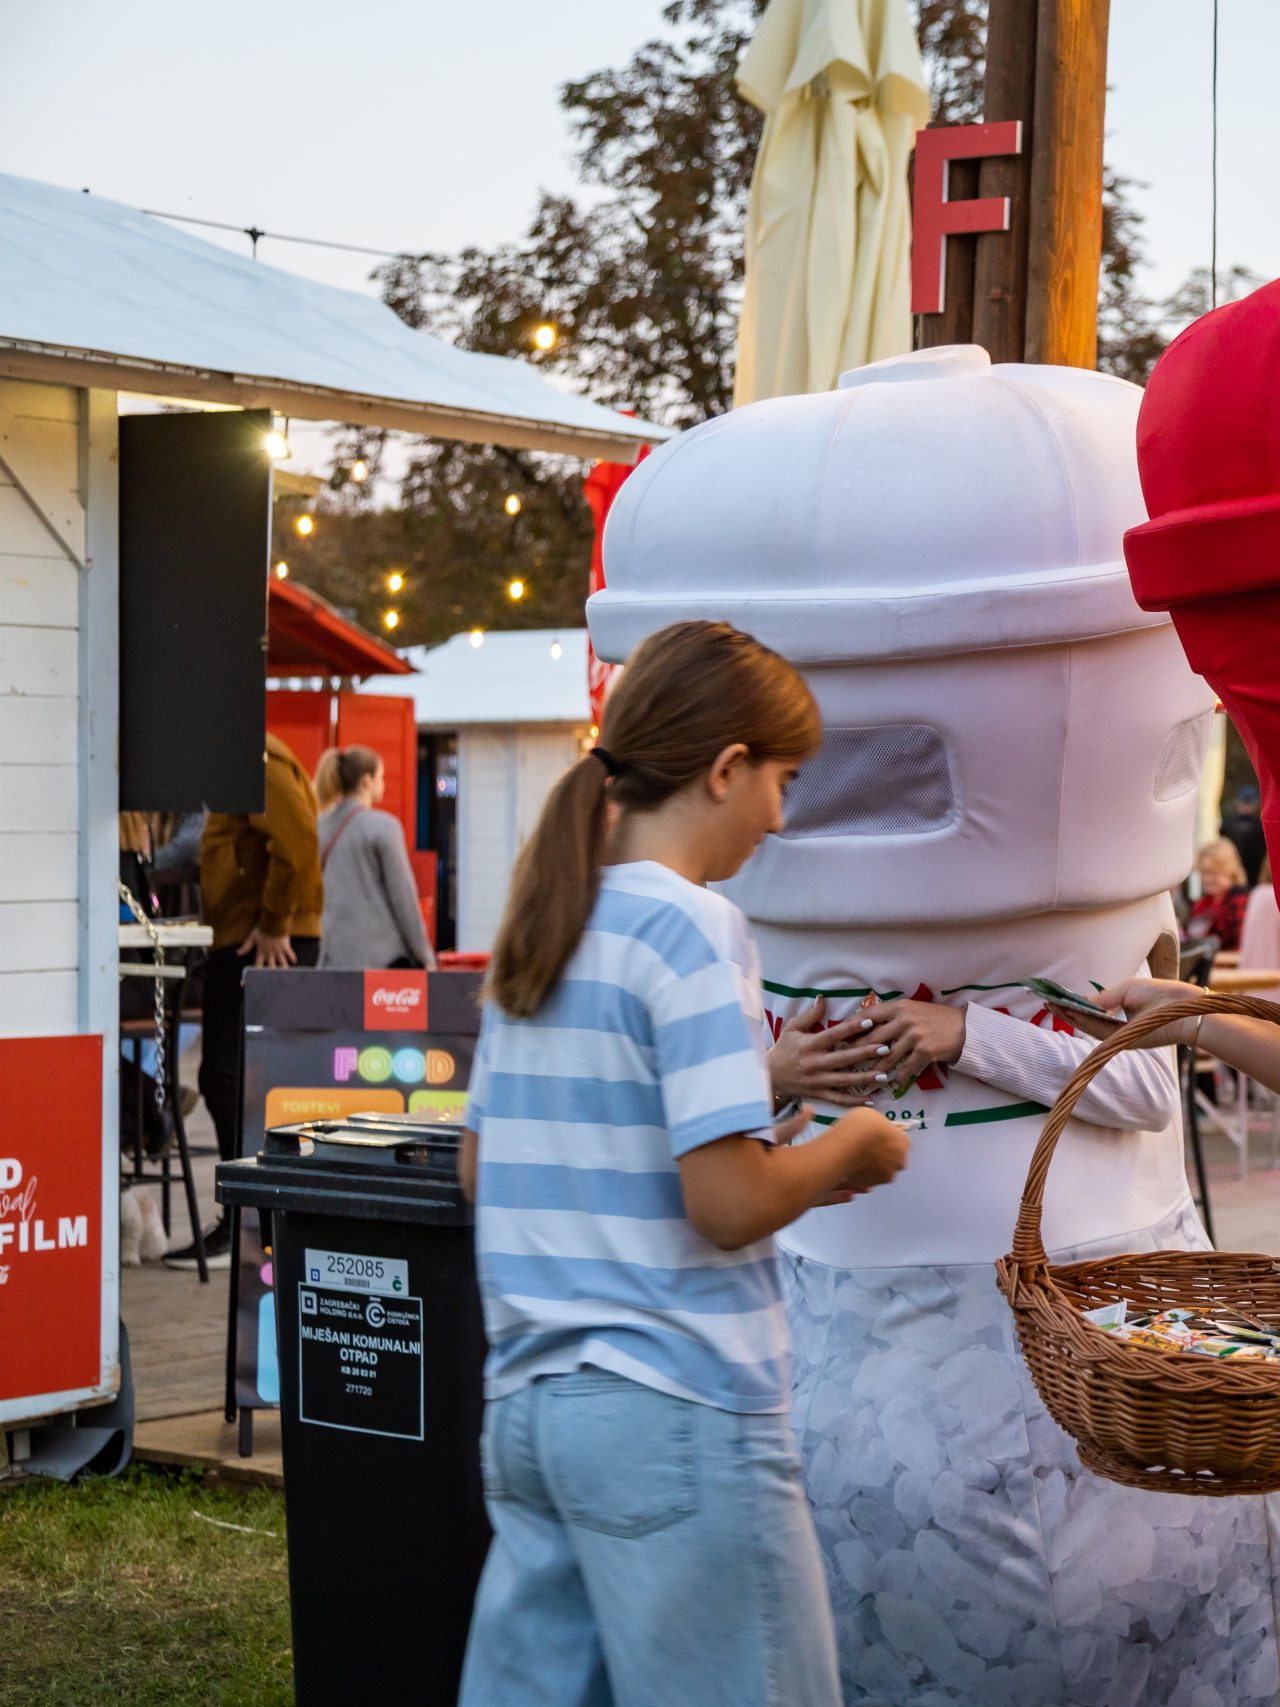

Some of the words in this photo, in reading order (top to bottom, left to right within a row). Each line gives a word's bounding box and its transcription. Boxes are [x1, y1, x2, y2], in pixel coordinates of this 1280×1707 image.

[911, 119, 1023, 314] F
[333, 1047, 455, 1084] FOOD
[327, 1255, 384, 1279] 252085
[319, 1306, 347, 1318] HOLDING
[301, 1326, 350, 1345] MIJEŠANI
[352, 1333, 421, 1355] KOMUNALNI
[340, 1347, 378, 1365] OTPAD
[345, 1383, 373, 1397] 271720
